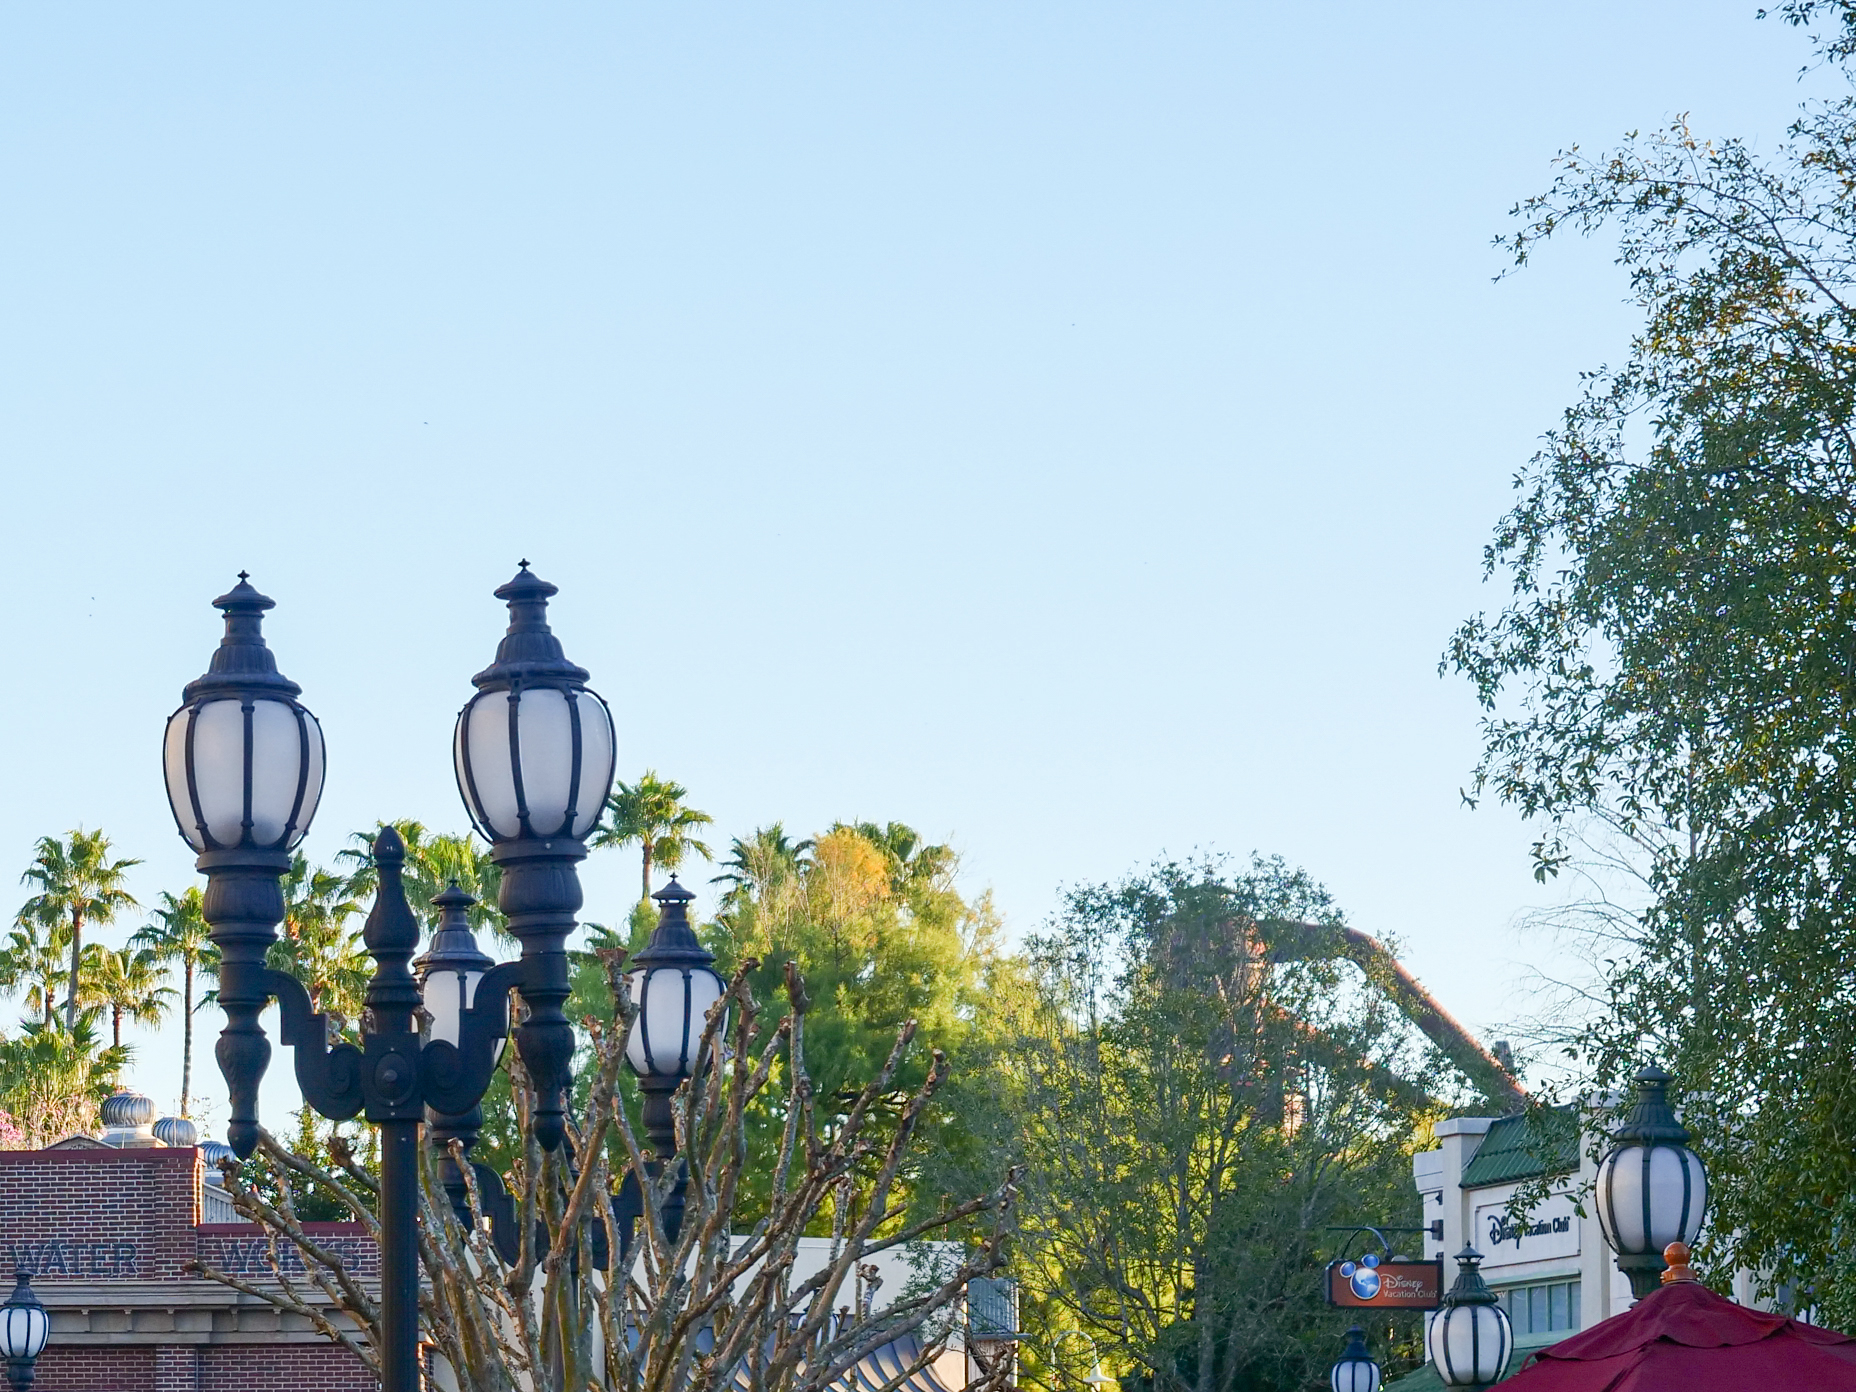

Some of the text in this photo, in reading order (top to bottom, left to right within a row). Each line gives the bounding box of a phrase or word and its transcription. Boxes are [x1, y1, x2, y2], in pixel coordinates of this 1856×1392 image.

[8, 1241, 139, 1277] WATER
[1384, 1290, 1436, 1298] Vacation Club
